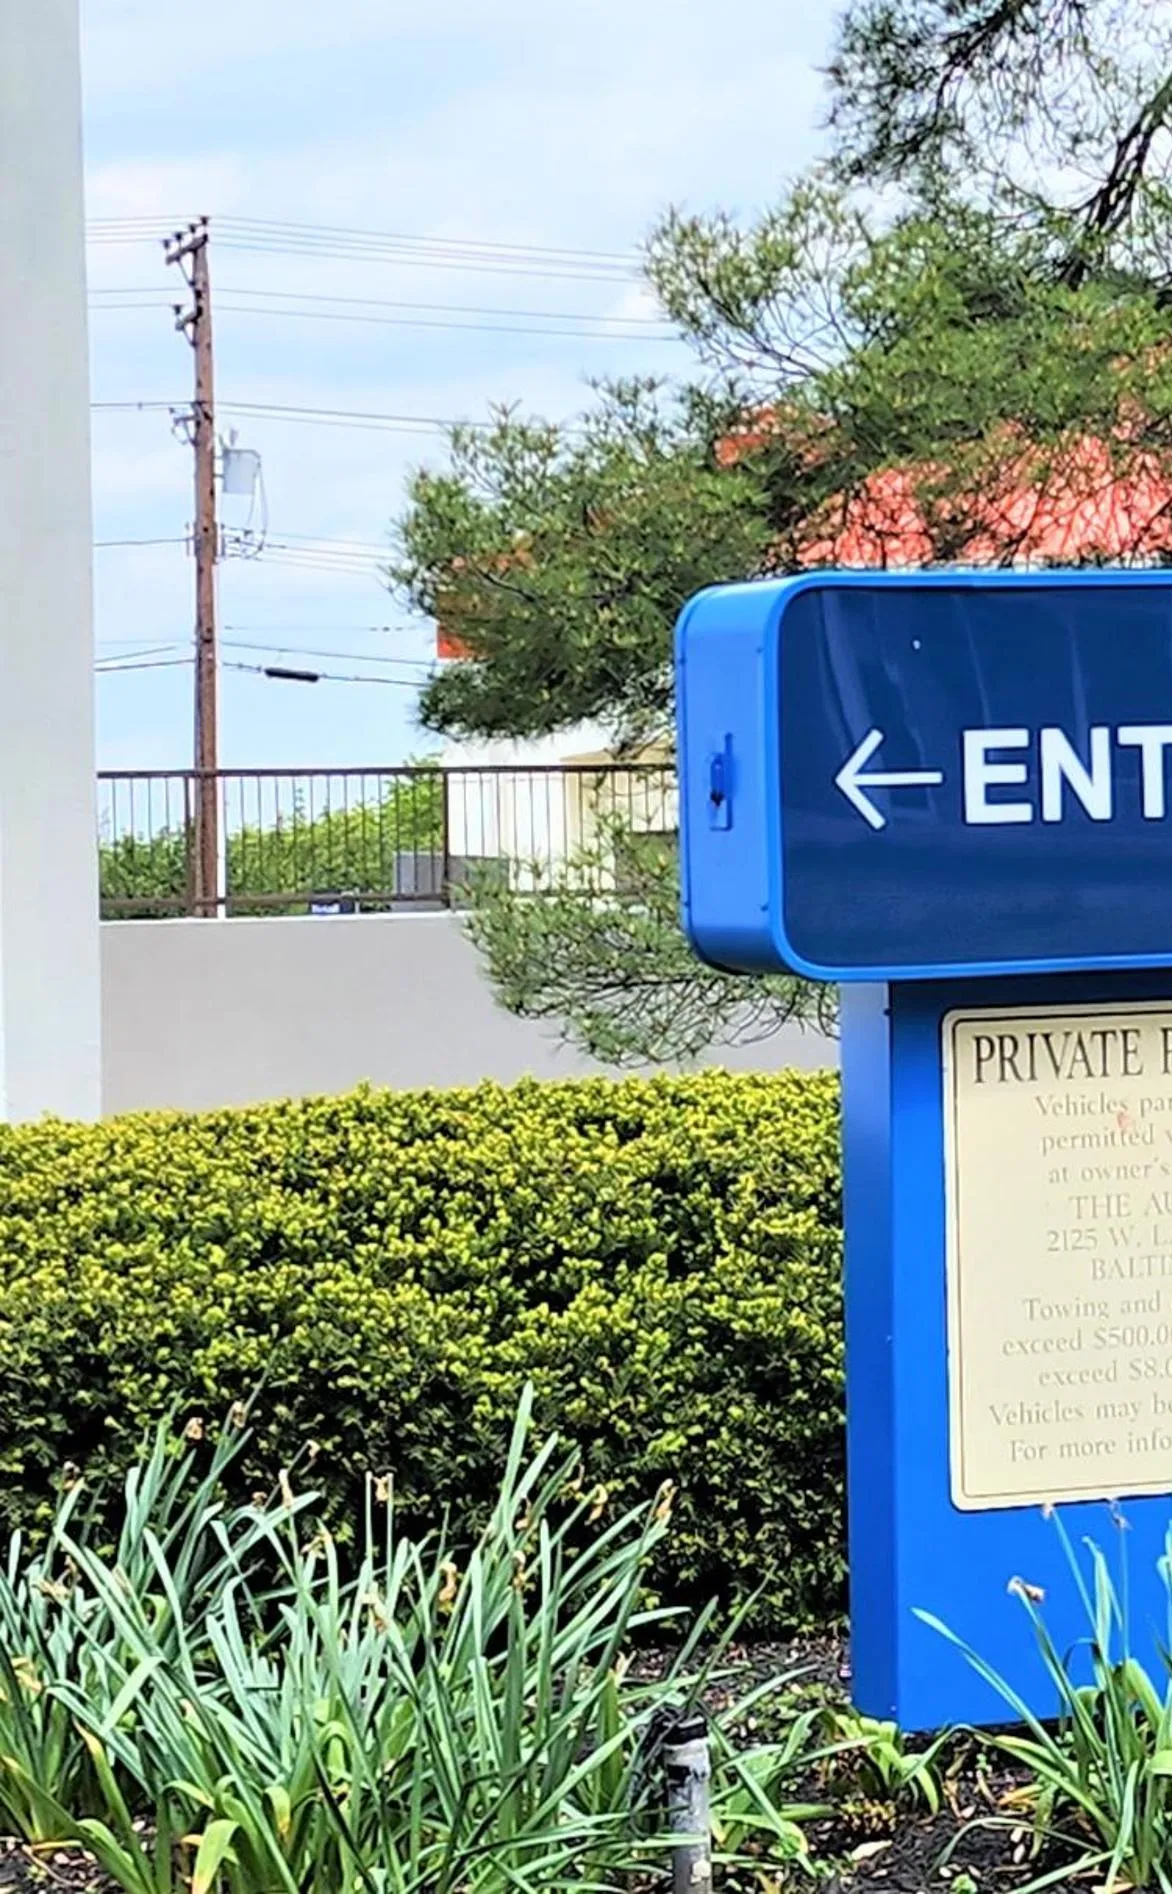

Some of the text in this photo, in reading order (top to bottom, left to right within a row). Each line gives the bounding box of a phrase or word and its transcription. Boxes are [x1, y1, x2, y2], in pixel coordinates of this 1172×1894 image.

[972, 1028, 1145, 1084] PRIVATE
[1035, 1091, 1129, 1117] Vehicles
[1041, 1123, 1154, 1157] permitted
[1048, 1165, 1069, 1184] at
[1080, 1156, 1170, 1183] owner's
[1068, 1192, 1132, 1220] THE
[1047, 1228, 1098, 1252] 2125
[1108, 1225, 1142, 1248] W.
[1022, 1297, 1110, 1322] Towing
[1120, 1289, 1161, 1315] and
[1002, 1329, 1083, 1357] exceed
[1038, 1359, 1118, 1388] exceed
[989, 1400, 1085, 1427] Vehicles
[1096, 1398, 1142, 1422] may
[1010, 1439, 1048, 1464] For
[1060, 1437, 1116, 1459] more
